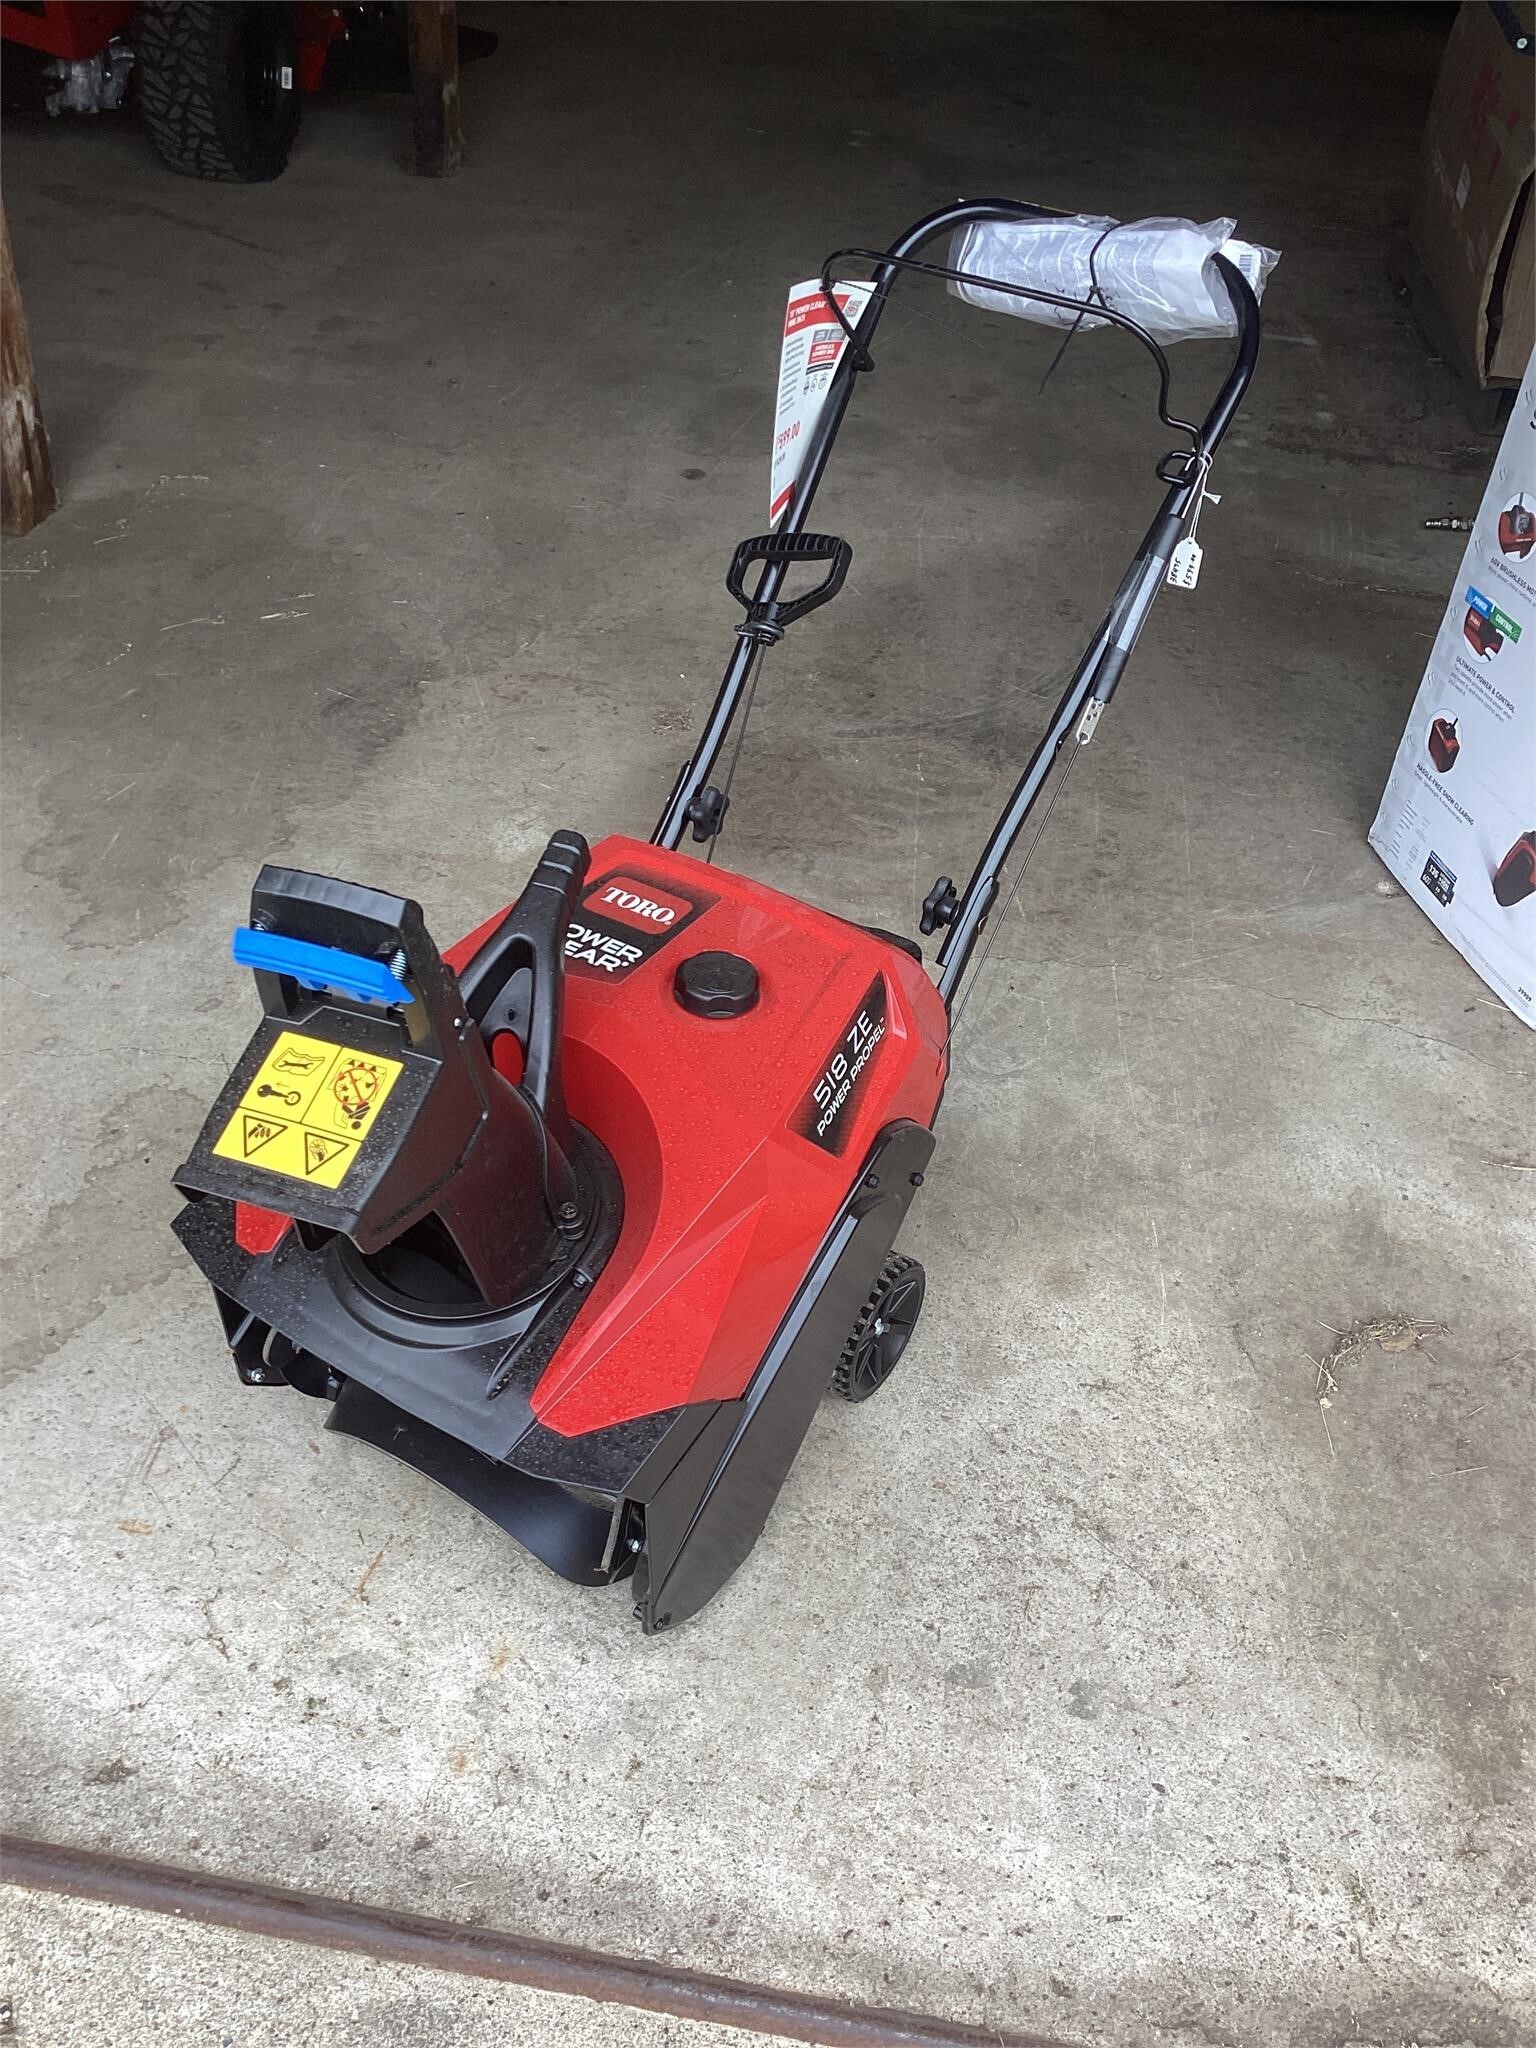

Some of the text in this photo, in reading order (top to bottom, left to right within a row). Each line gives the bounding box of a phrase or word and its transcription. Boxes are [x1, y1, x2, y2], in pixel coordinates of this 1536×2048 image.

[1500, 563, 1527, 588] BRUSHLESS
[1474, 596, 1488, 610] POWER
[1495, 615, 1514, 631] CONTROL
[1456, 656, 1477, 677] ULTIMATE
[1474, 674, 1492, 692] POWER
[1496, 691, 1516, 713] CONTROL
[1417, 762, 1443, 791] HASSLE-FREE
[1440, 789, 1455, 805] SNOW
[1454, 801, 1475, 825] CLEARING
[600, 887, 675, 921] TORO
[564, 940, 622, 972] EAR
[567, 923, 643, 962] OWER
[812, 1010, 873, 1109] 518 ZE
[816, 1079, 852, 1136] POWER
